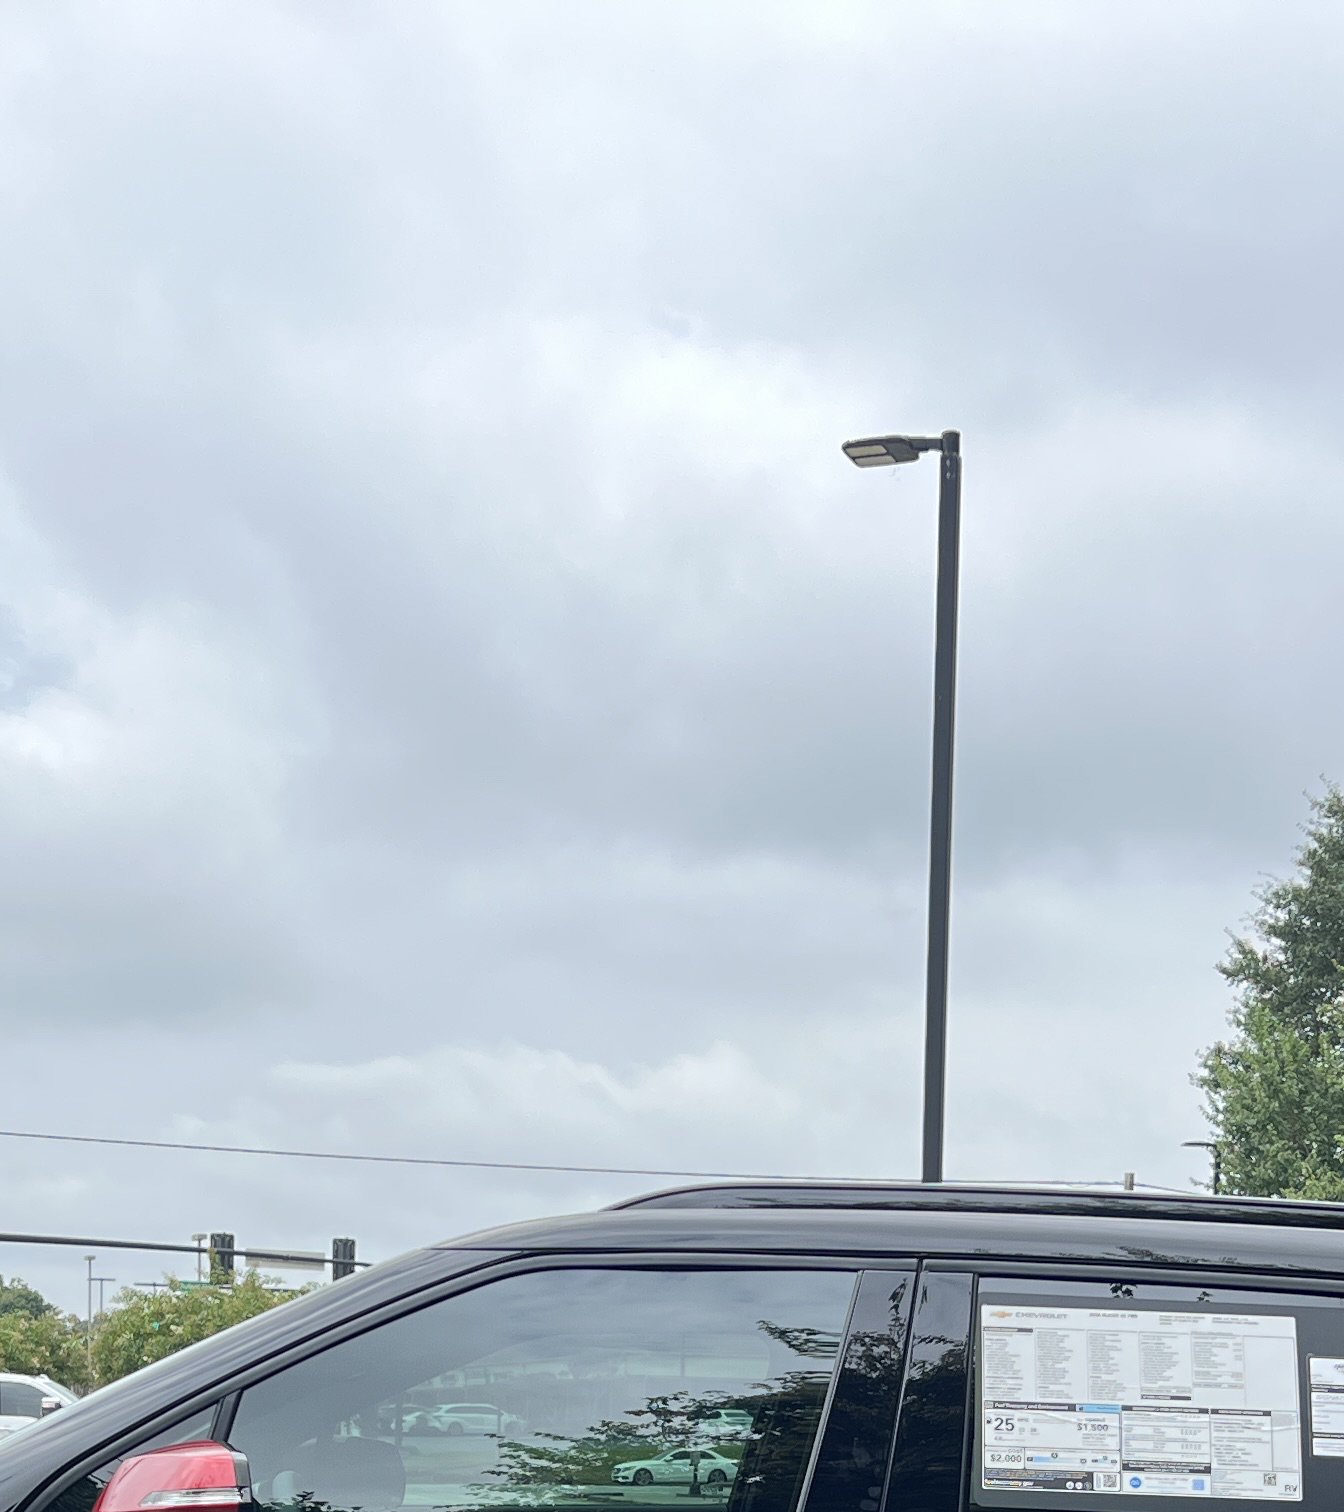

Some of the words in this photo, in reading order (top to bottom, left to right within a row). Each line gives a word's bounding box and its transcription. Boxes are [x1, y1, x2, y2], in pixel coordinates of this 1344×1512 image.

[1015, 1311, 1068, 1319] CHEVROLET
[994, 1417, 1015, 1431] 25
[1077, 1422, 1109, 1432] $1,500
[990, 1454, 1022, 1463] $2,000
